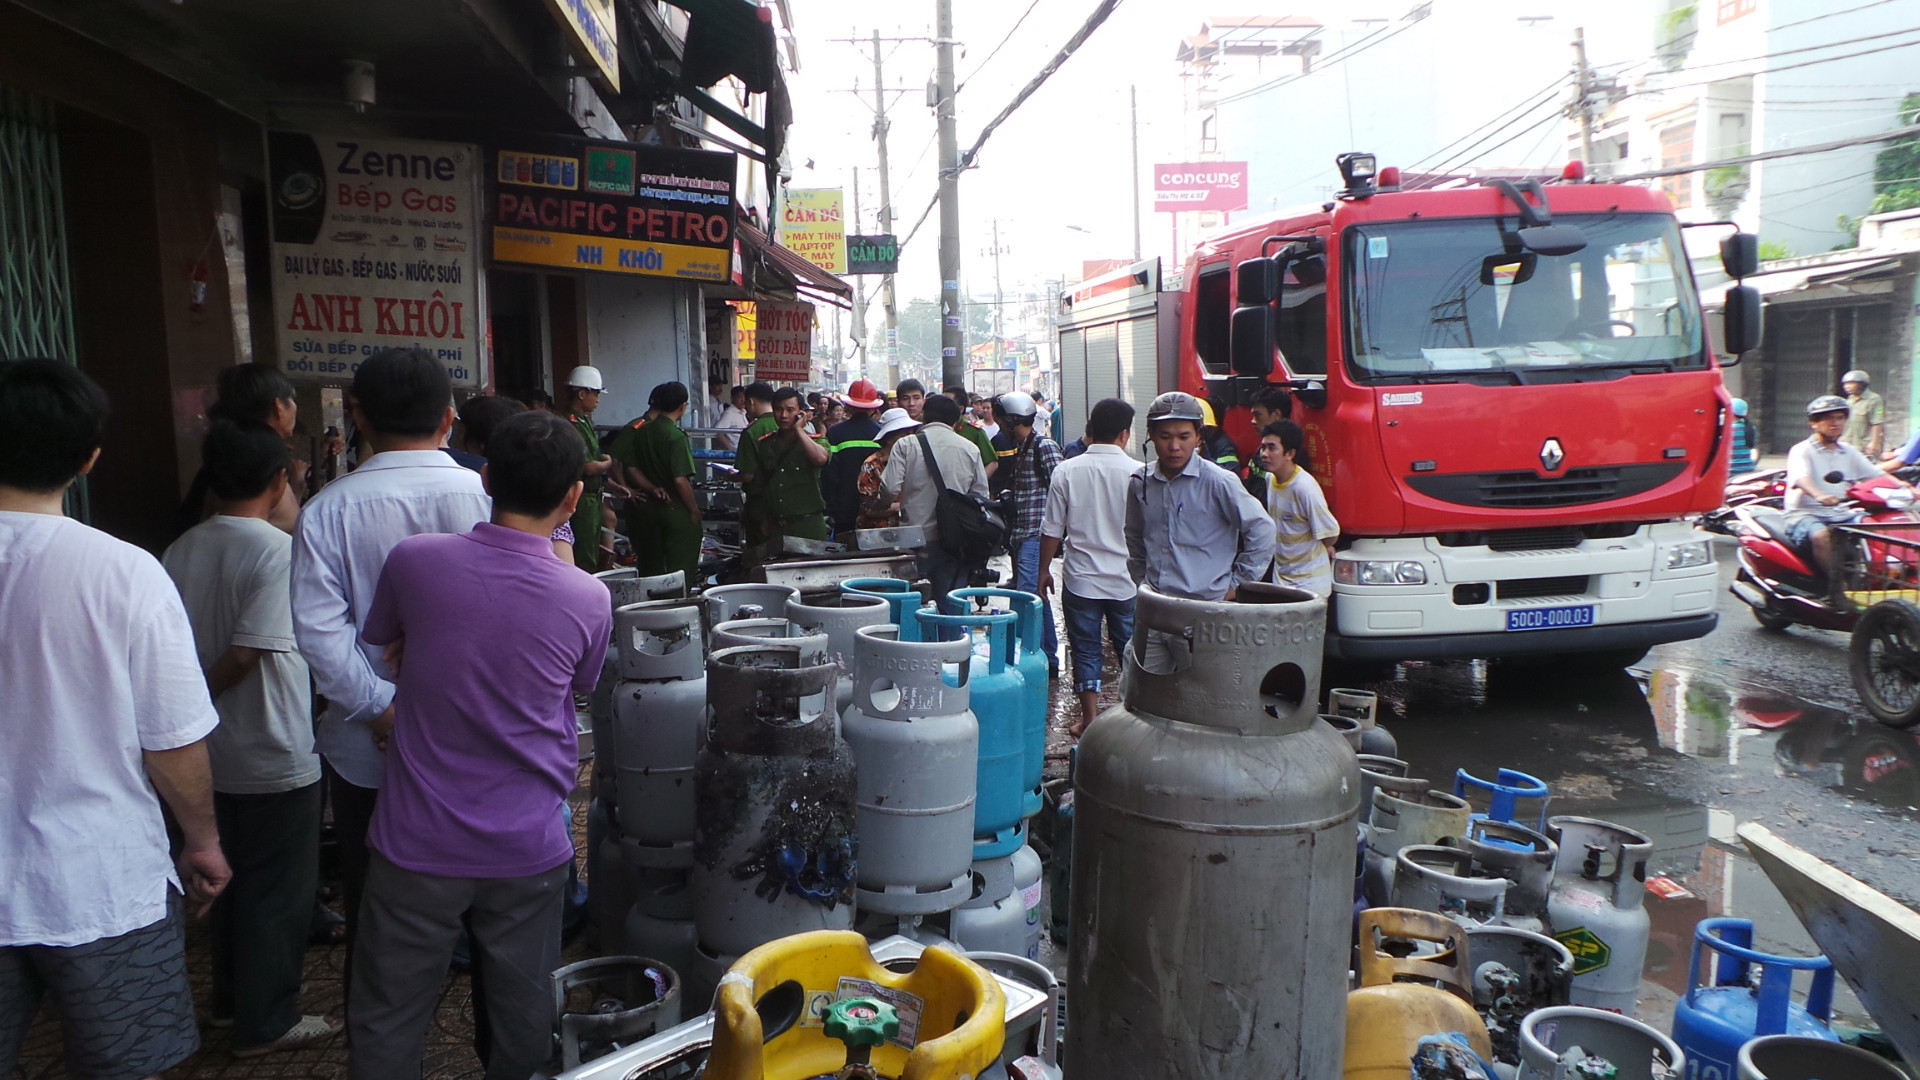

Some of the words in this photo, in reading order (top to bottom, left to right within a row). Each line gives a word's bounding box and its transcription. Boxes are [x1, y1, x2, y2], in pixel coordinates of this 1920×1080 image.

[336, 142, 456, 181] Zenne
[588, 180, 615, 191] PACIFIC
[616, 184, 631, 193] GAS
[1160, 172, 1242, 189] concung
[337, 181, 393, 213] Bếp
[401, 187, 457, 213] Gas
[498, 193, 617, 233] PACIFIC
[626, 206, 729, 243] PETRO
[792, 230, 817, 240] MÁY
[818, 230, 842, 240] TÍNH
[618, 246, 664, 271] KHÔI
[793, 242, 835, 252] LAPTOP
[811, 250, 835, 260] MÁY
[878, 238, 895, 261] ĐỒ
[285, 255, 304, 279] ĐẠI
[306, 252, 320, 276] LÝ
[322, 258, 346, 278] GAS
[352, 252, 373, 279] BẾP
[376, 260, 398, 281] GAS
[406, 259, 436, 283] NƯỚC
[437, 258, 462, 285] SUỐI
[287, 292, 364, 334] ANH
[373, 288, 466, 340] KHÔI
[759, 305, 783, 331] HỚT
[785, 306, 809, 333] TÓC
[292, 338, 324, 354] SỬA
[328, 339, 357, 356] BẾP
[437, 347, 462, 362] PHÍ
[758, 336, 780, 359] GỘI
[782, 333, 808, 356] ĐẦU
[286, 354, 314, 373] ĐỔI
[318, 357, 347, 374] BẾP
[1511, 608, 1590, 628] 50CD-000.03
[1564, 938, 1600, 956] SP
